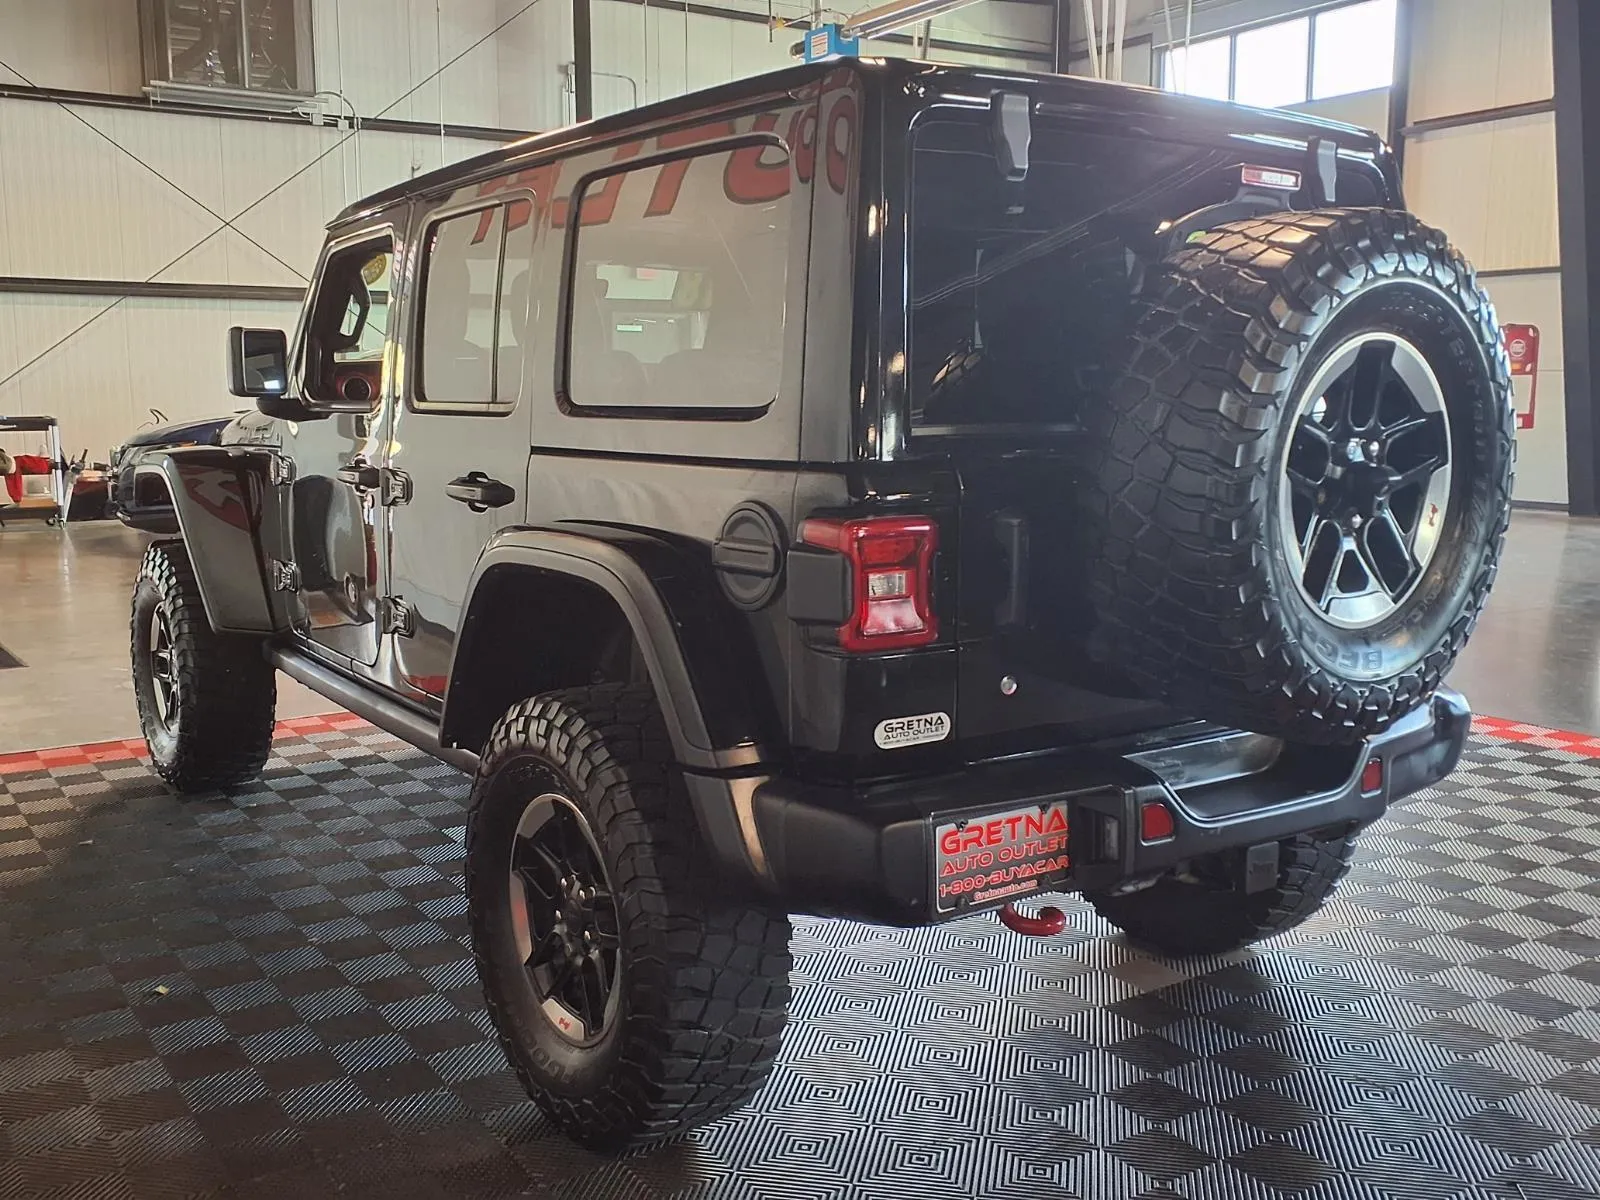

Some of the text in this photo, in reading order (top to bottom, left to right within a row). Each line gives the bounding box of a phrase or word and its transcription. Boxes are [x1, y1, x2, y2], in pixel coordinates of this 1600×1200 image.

[884, 715, 945, 733] GRETNA
[884, 731, 910, 741] AUTO
[912, 725, 945, 736] OUTLET
[941, 807, 1068, 856] GRETNA
[940, 836, 1068, 877] AUTO OUTLET
[940, 855, 1069, 897] 1-800-BUYACAR
